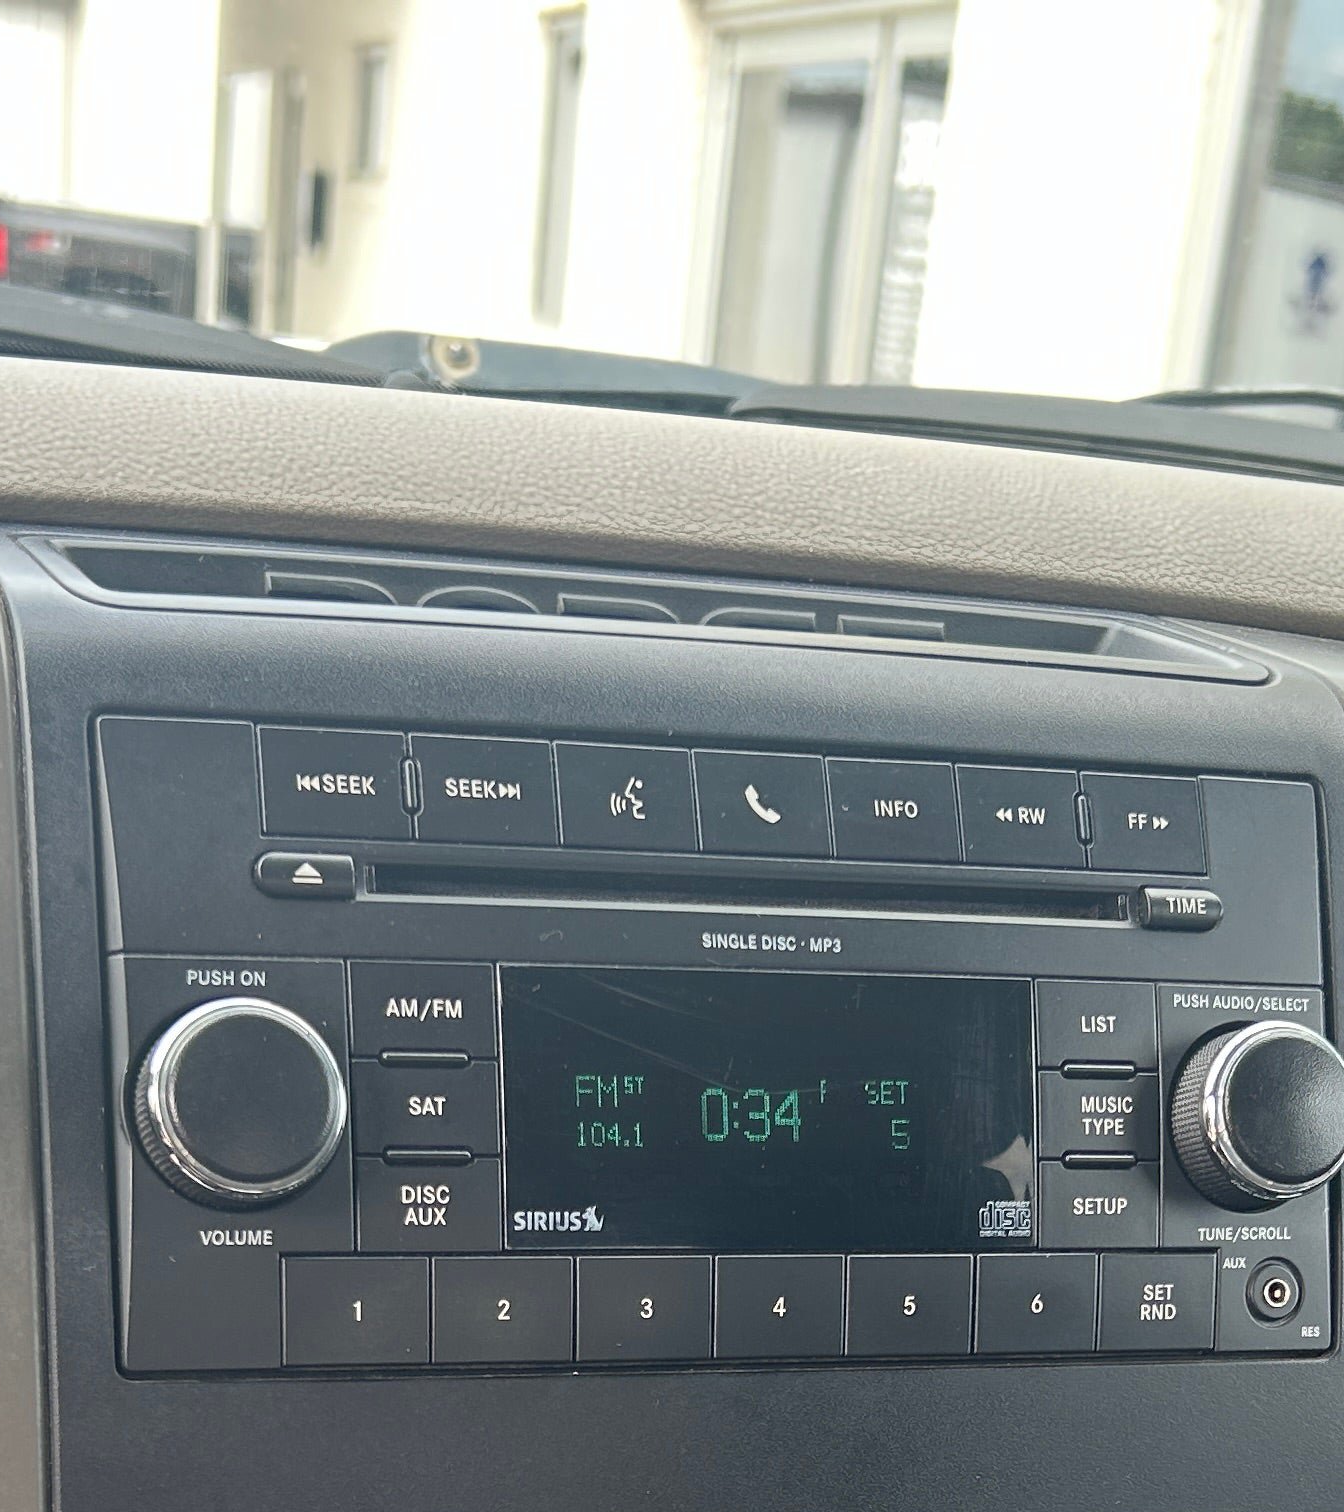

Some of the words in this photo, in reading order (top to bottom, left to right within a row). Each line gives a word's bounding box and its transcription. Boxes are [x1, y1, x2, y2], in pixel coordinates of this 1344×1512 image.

[322, 774, 375, 795] SEEK
[446, 778, 497, 799] SEEK
[875, 800, 917, 818] INFO
[1018, 807, 1045, 824] RW
[1128, 813, 1147, 829] FF
[1165, 897, 1207, 915] TIME
[702, 933, 757, 949] SINGLE
[762, 935, 796, 951] DISC
[810, 938, 841, 952] MP3
[187, 970, 233, 985] PUSH
[241, 970, 265, 986] ON
[386, 998, 462, 1021] AM/FM
[1174, 994, 1209, 1008] PUSH
[1211, 993, 1310, 1013] AUDIO/SELECT
[1082, 1016, 1116, 1032] LIST
[576, 1076, 617, 1107] FM
[865, 1081, 908, 1104] SET
[409, 1097, 446, 1115] SAT
[1082, 1096, 1132, 1113] MUSIC
[578, 1122, 643, 1147] 104.1
[892, 1120, 909, 1149] 5
[1082, 1118, 1124, 1135] TYPE
[402, 1185, 449, 1204] DISC
[1073, 1198, 1127, 1215] SETUP
[405, 1208, 446, 1225] AUX
[514, 1211, 581, 1231] SIRIUS
[200, 1230, 272, 1245] VOLUME
[1198, 1227, 1291, 1243] TUNE/SCROLL
[1223, 1257, 1246, 1269] AUX
[1144, 1284, 1174, 1300] SET
[353, 1301, 361, 1321] 1
[498, 1300, 510, 1320] 2
[641, 1298, 652, 1318] 3
[773, 1297, 786, 1317] 4
[904, 1296, 915, 1315] 5
[1032, 1294, 1043, 1313] 6
[1141, 1304, 1176, 1320] RND
[1302, 1326, 1320, 1337] RES
